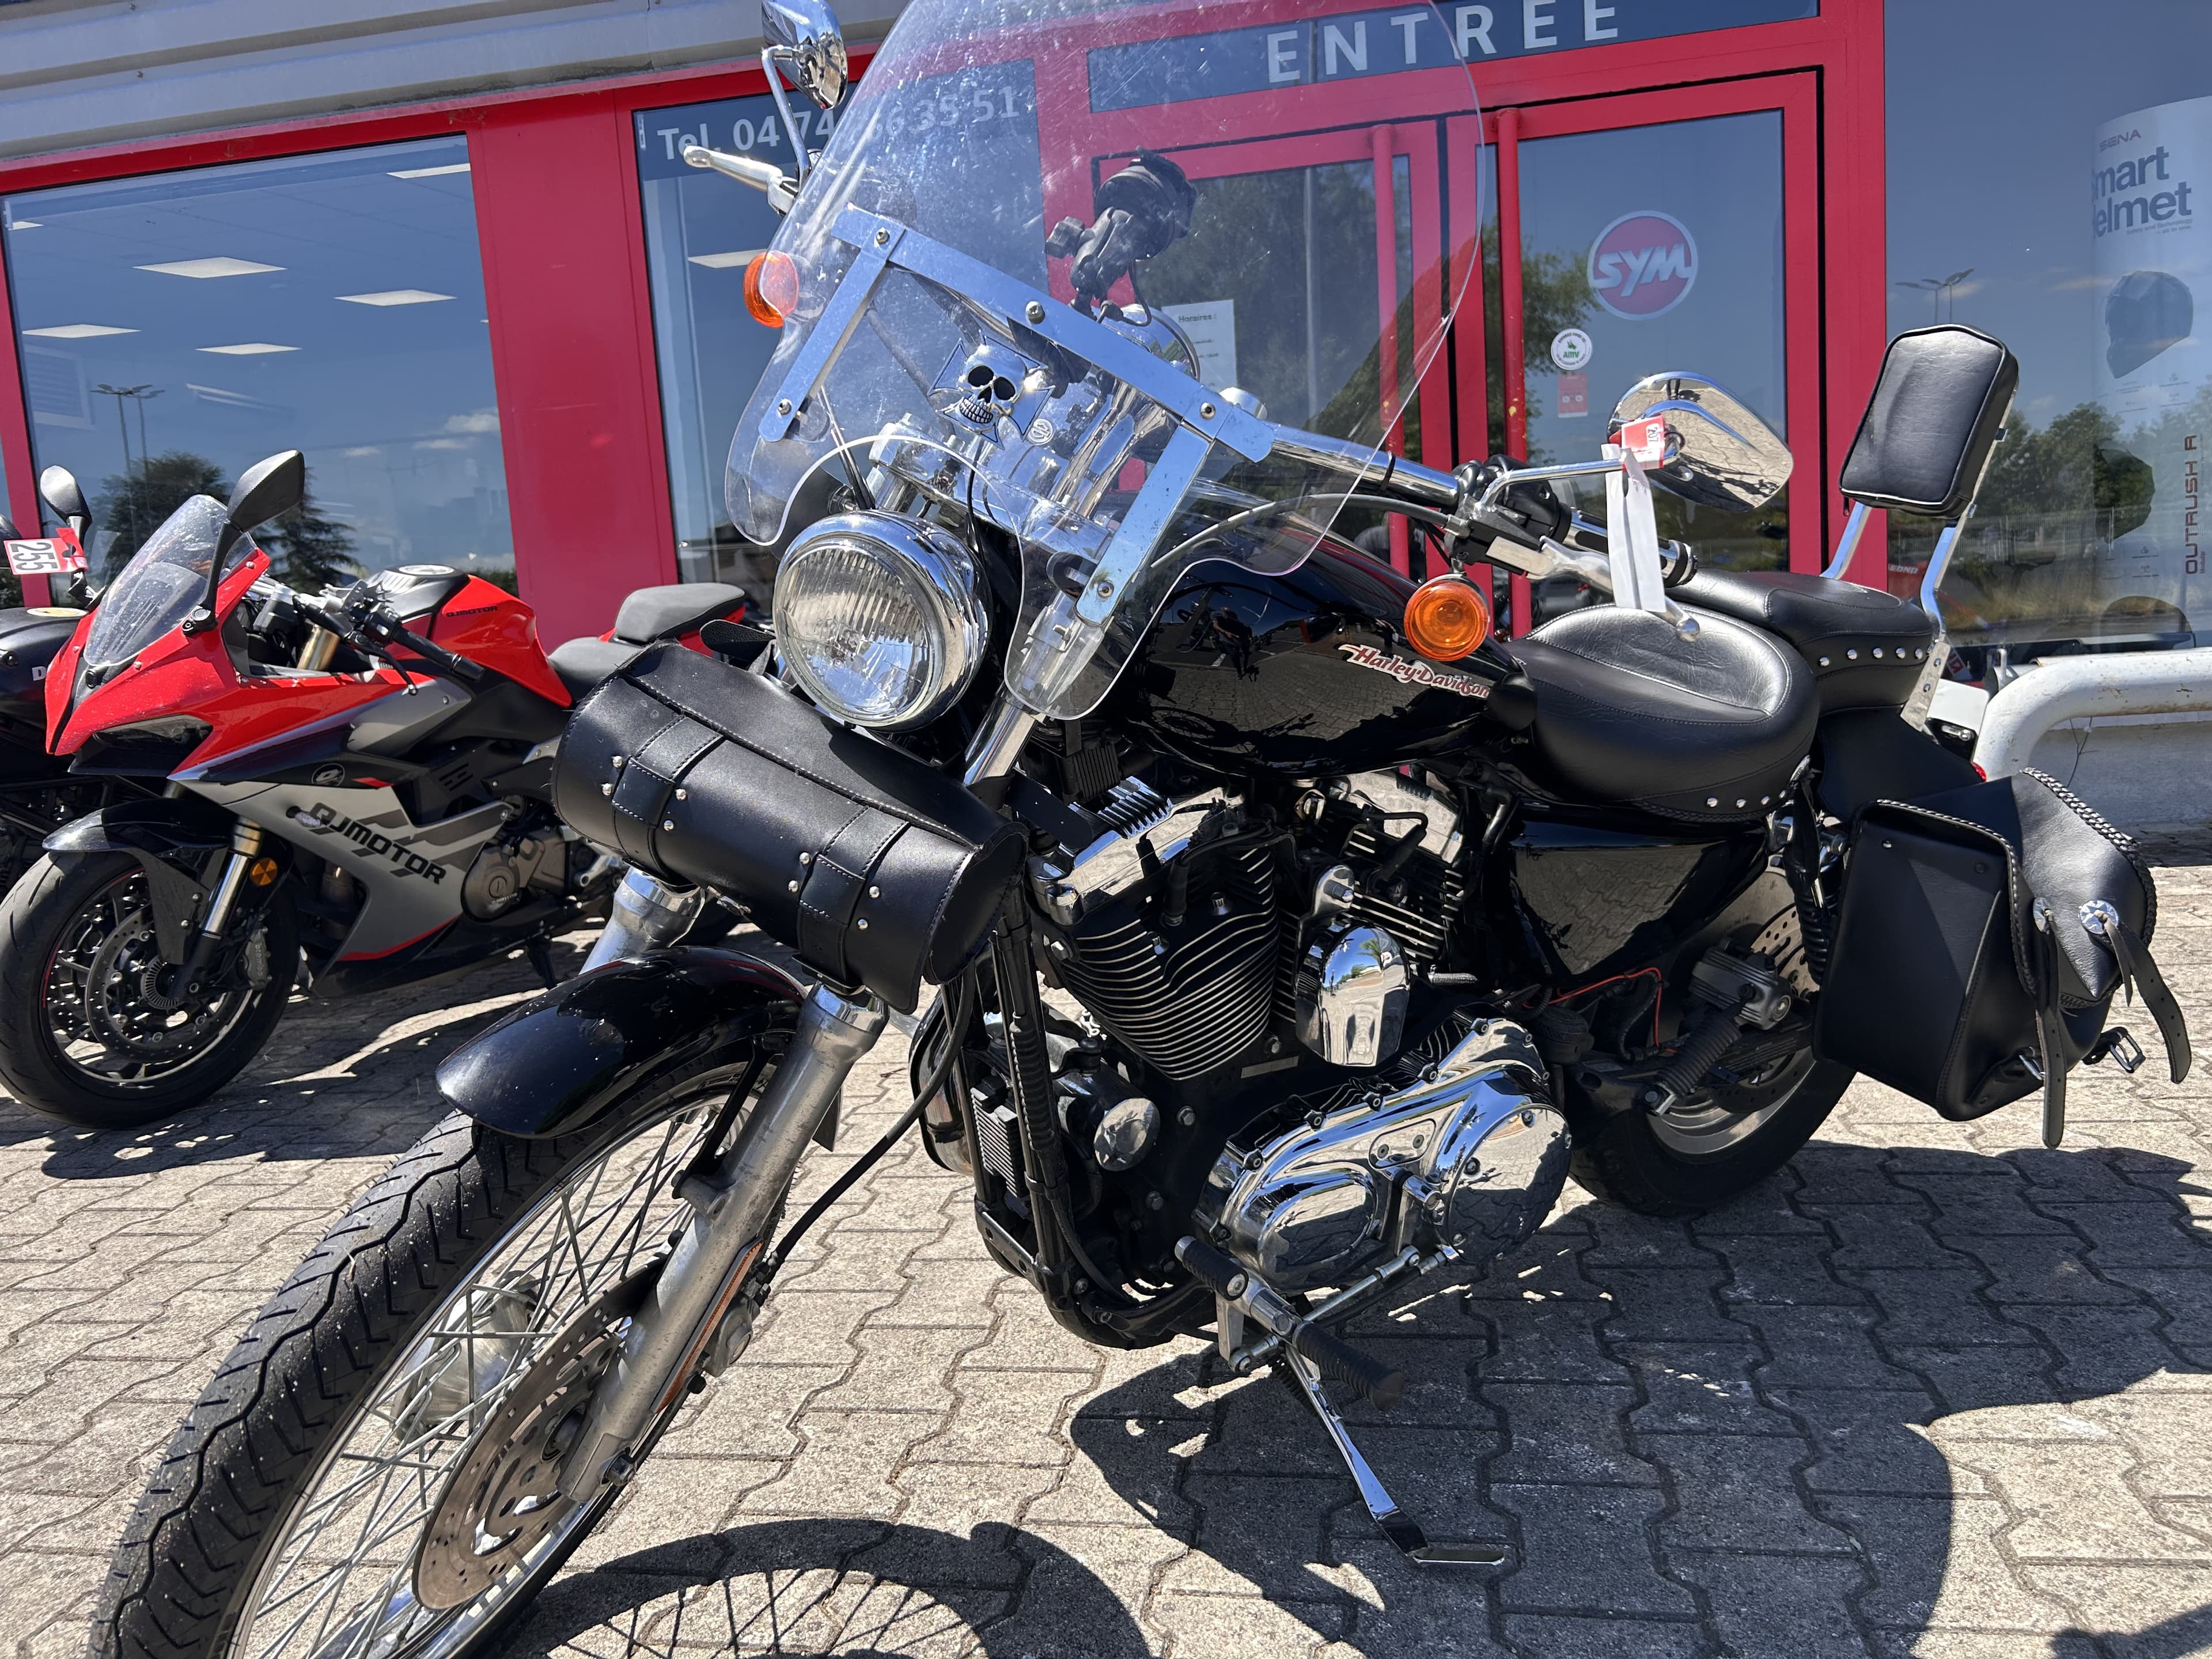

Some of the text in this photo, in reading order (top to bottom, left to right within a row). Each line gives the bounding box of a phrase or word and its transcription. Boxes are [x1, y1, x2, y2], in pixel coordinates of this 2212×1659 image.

[733, 117, 779, 151] 04
[974, 86, 1020, 122] 51
[2100, 129, 2141, 152] SENA
[1593, 243, 1692, 297] SYM
[1177, 314, 1212, 323] Horaires
[2185, 460, 2198, 574] OUTRUSH
[9, 541, 59, 571] 255
[309, 802, 447, 885] QJMOTOR
